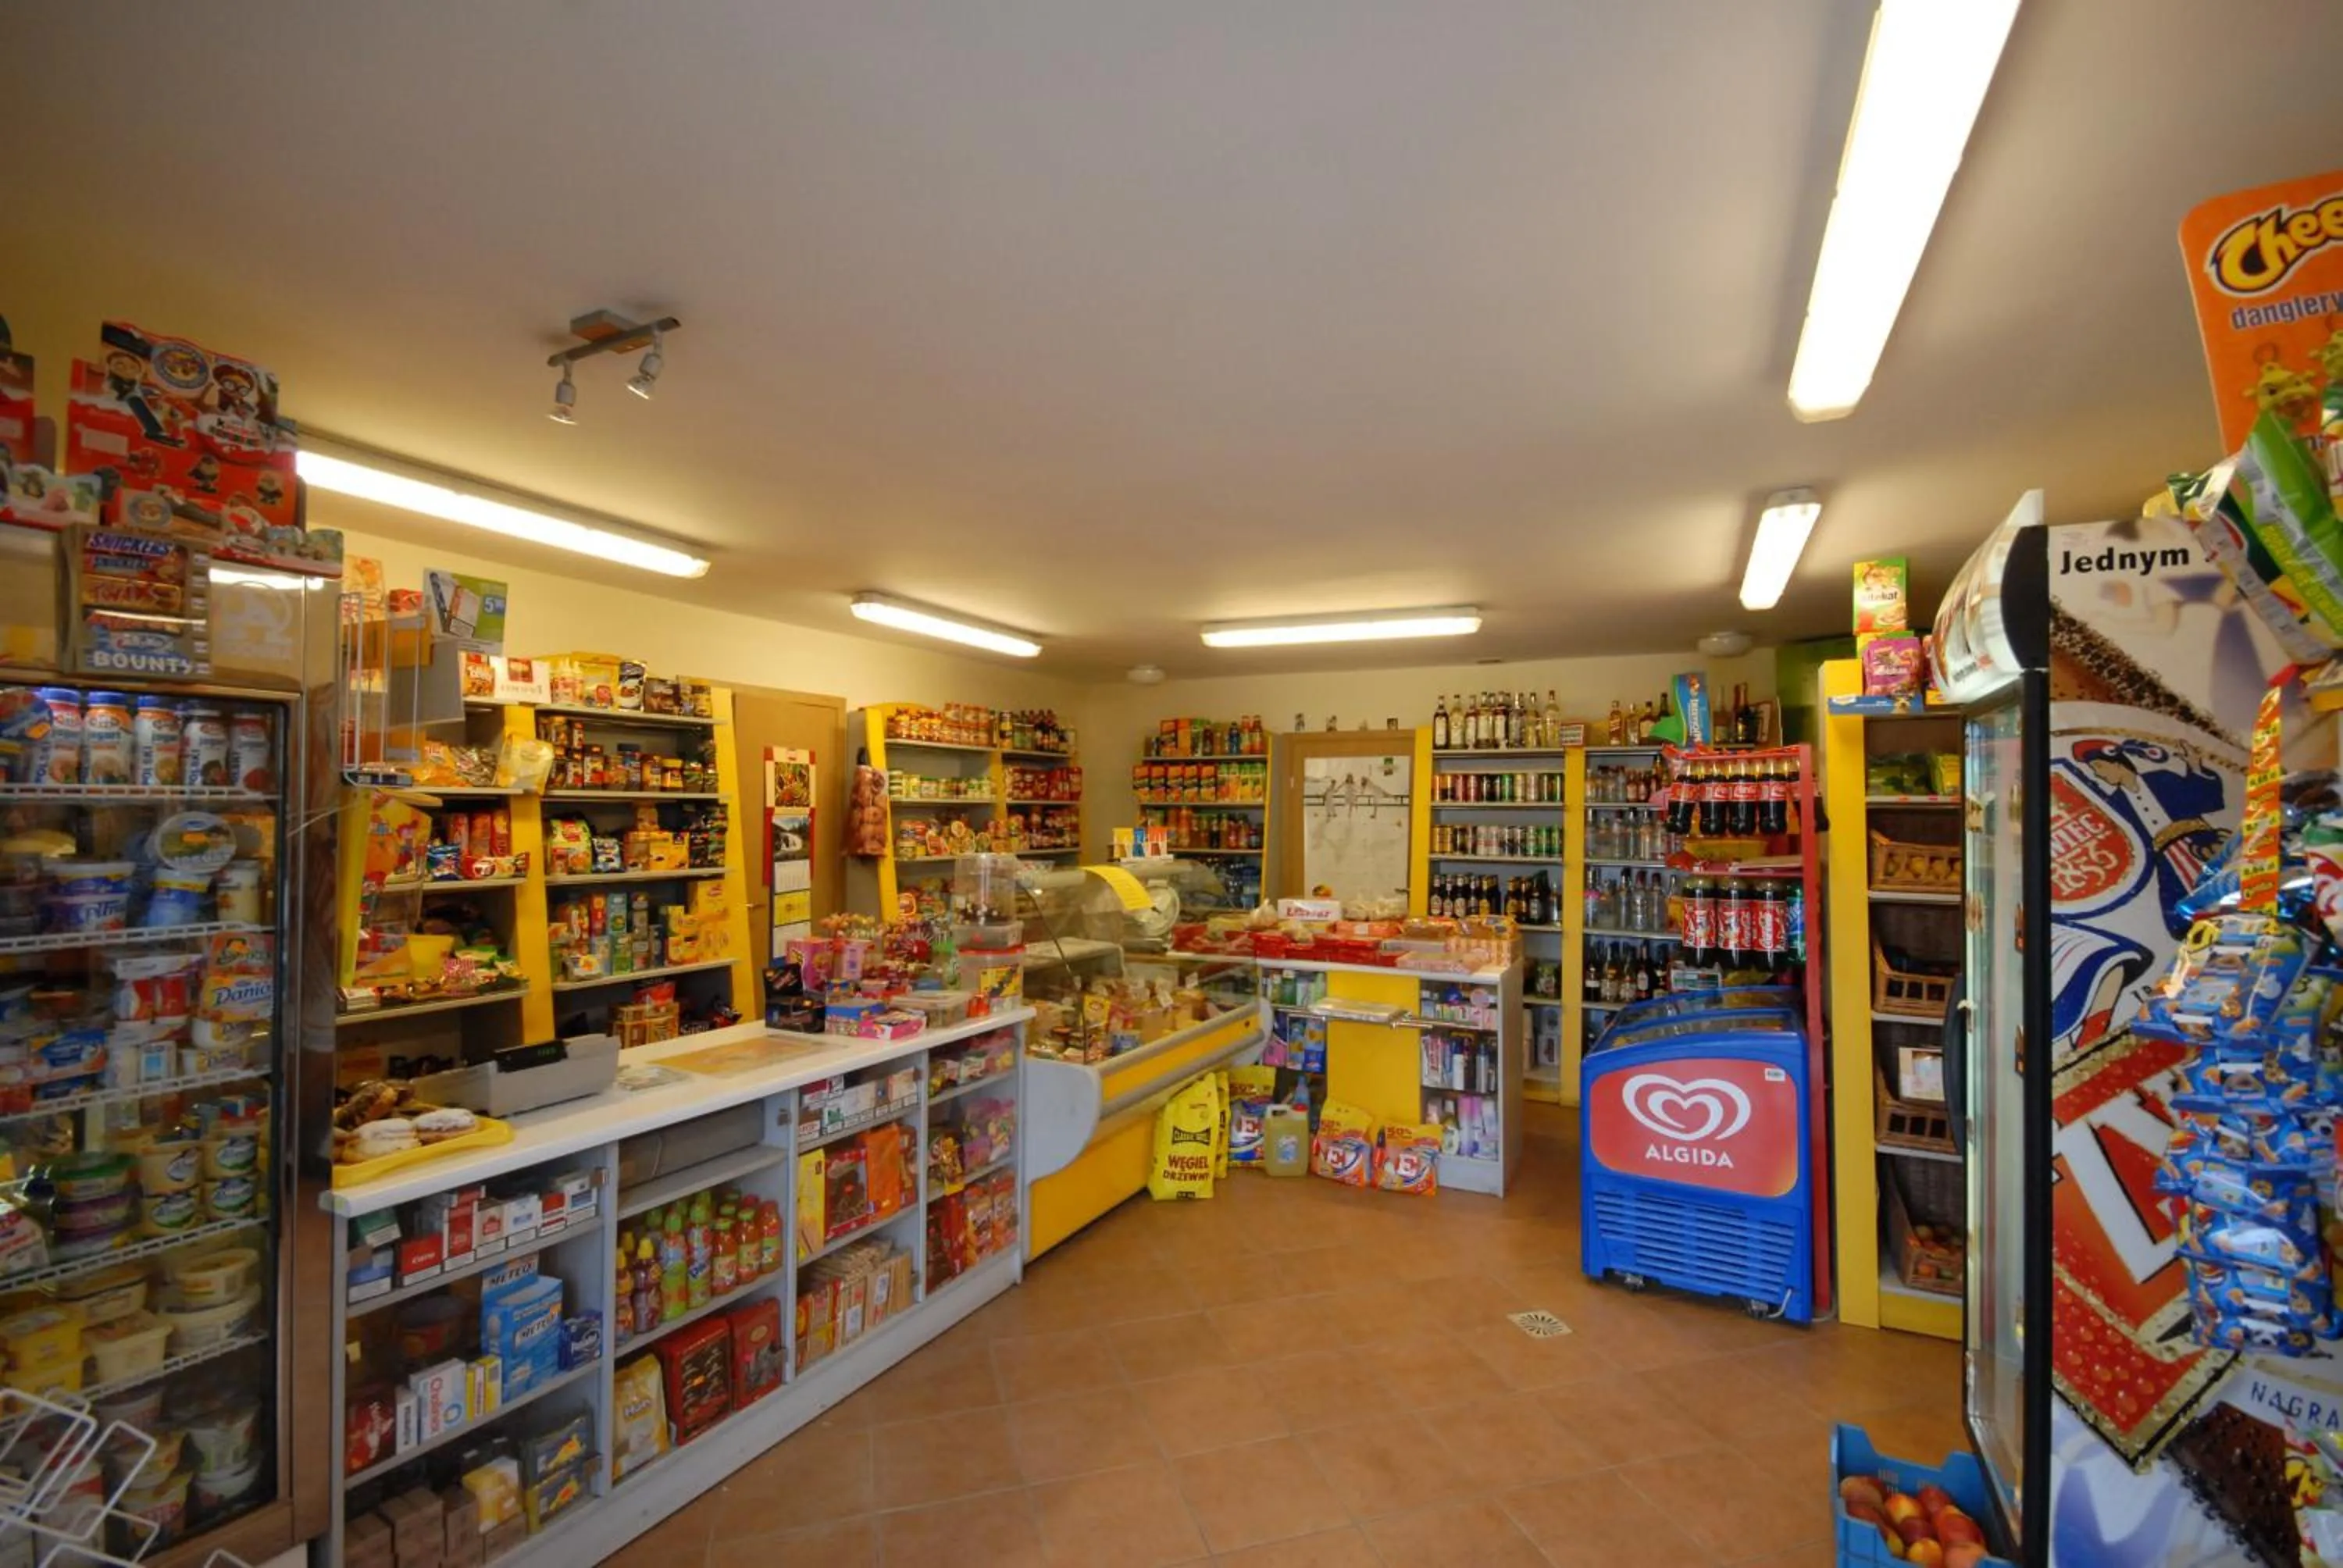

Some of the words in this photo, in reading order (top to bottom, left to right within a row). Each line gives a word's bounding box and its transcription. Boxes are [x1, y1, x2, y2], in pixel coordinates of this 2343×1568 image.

[2060, 547, 2190, 576] Jednym
[93, 650, 194, 675] BOUNTY
[1645, 1144, 1734, 1169] ALGIDA
